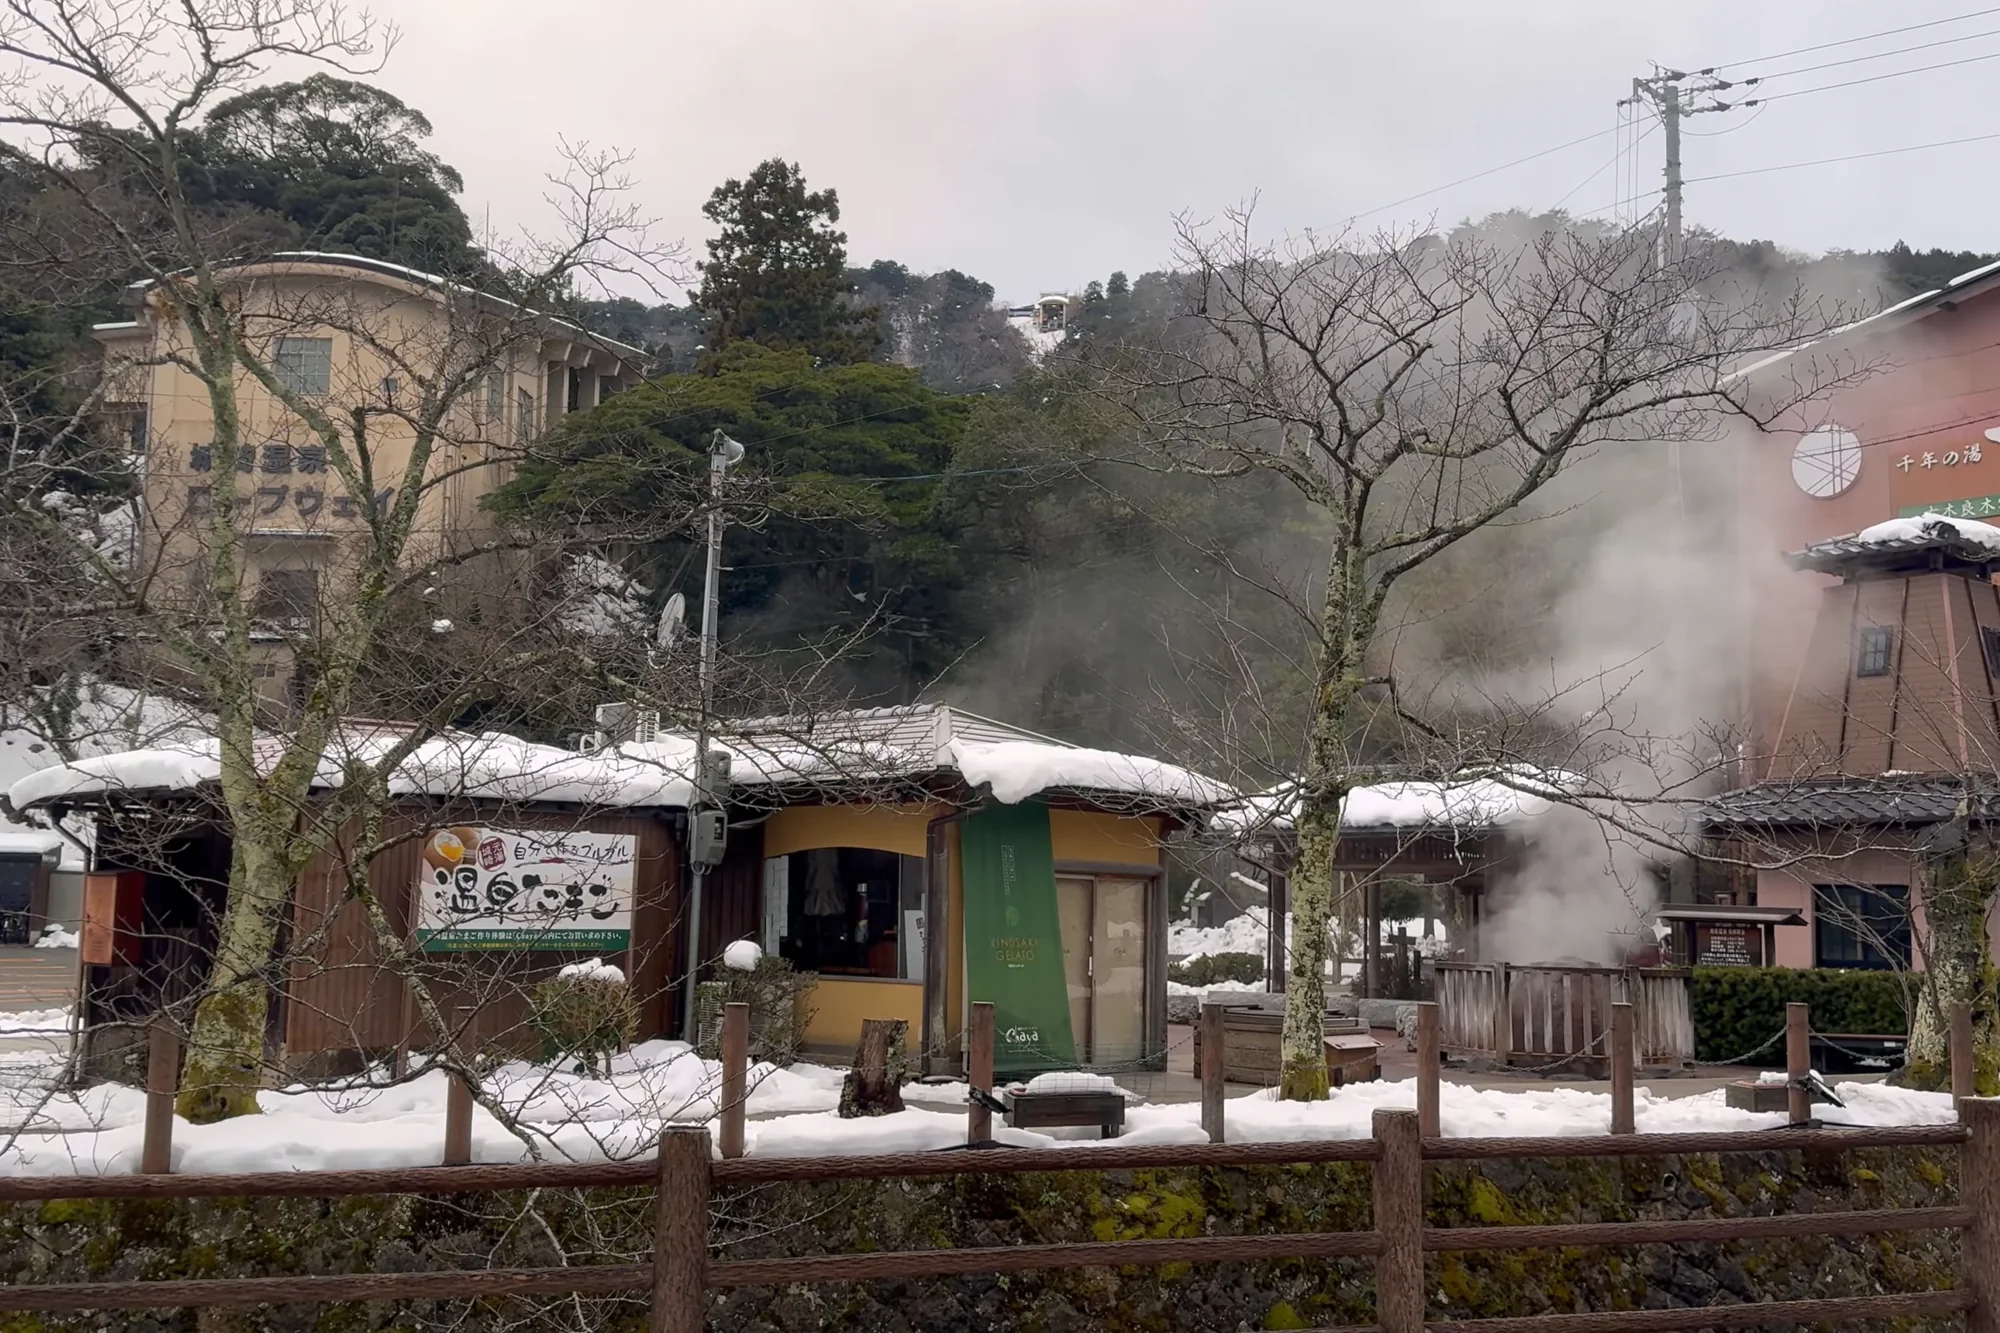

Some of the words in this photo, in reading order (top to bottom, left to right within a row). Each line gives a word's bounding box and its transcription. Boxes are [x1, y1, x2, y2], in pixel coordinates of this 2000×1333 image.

[1896, 443, 1983, 474] 千年の湯
[434, 867, 621, 924] 温泉たまご
[995, 950, 1034, 961] GELATO
